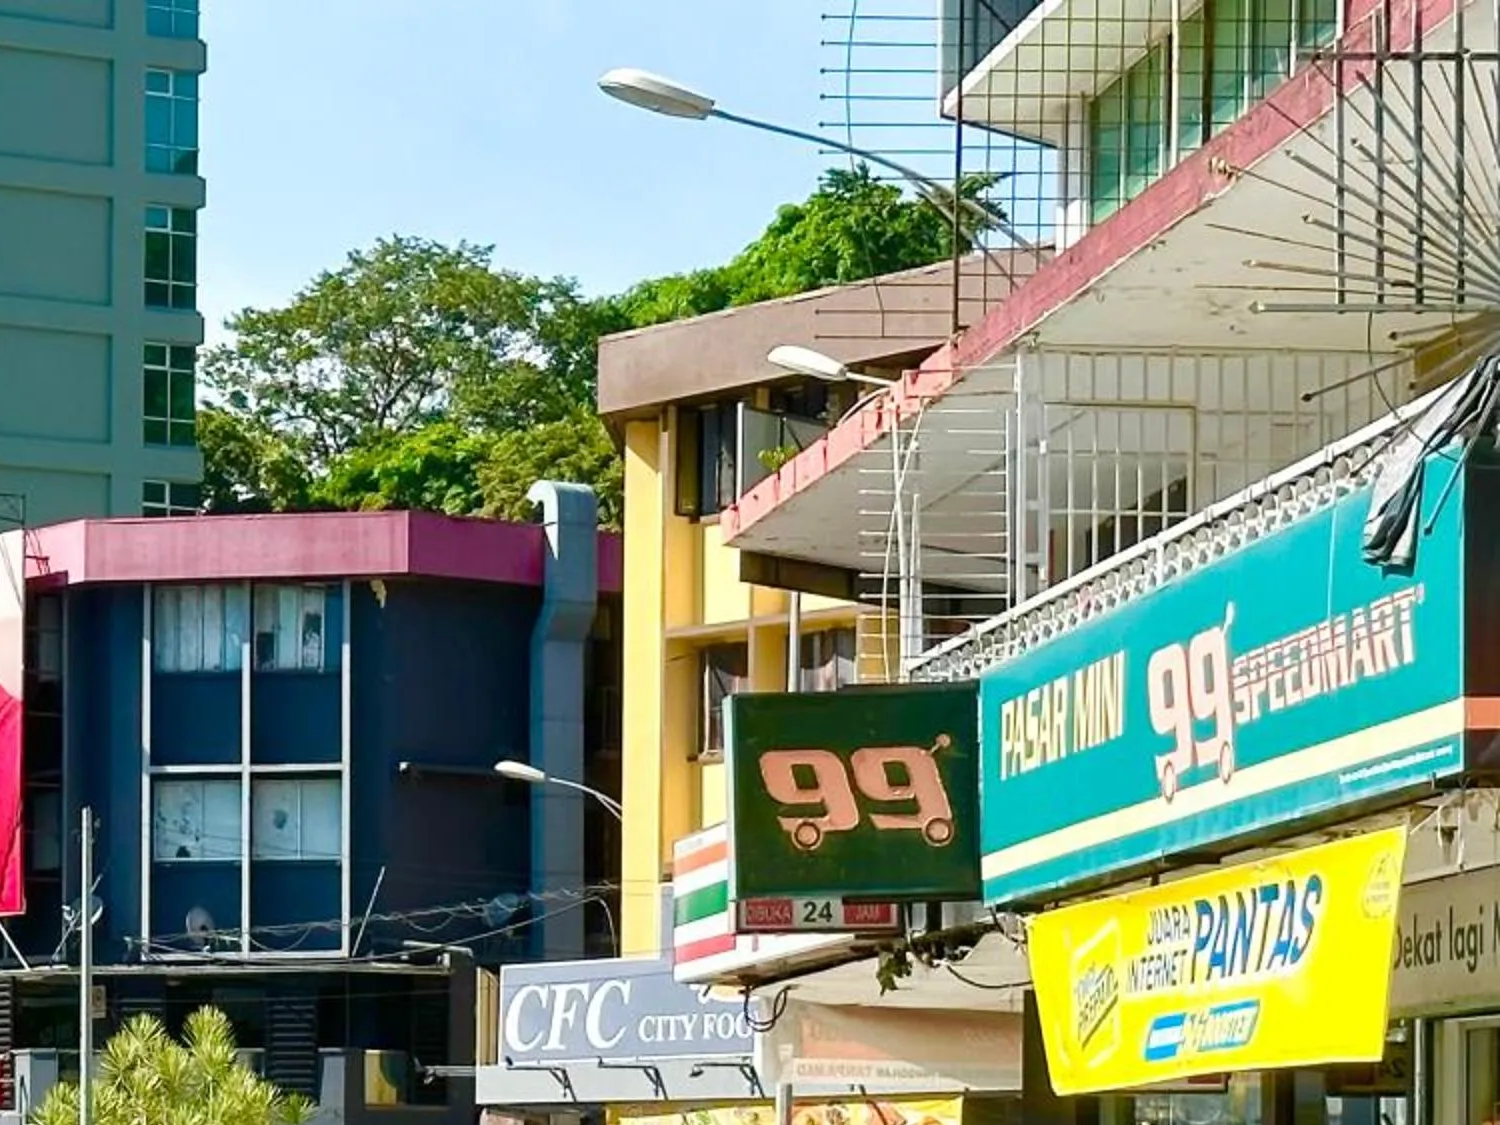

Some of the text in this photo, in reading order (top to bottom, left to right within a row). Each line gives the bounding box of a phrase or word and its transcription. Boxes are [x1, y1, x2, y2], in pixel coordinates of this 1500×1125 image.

[1001, 650, 1126, 780] PASAR MINI
[1148, 594, 1418, 802] 99 SPEEDMART
[760, 745, 955, 847] 99
[803, 901, 833, 923] 24
[1148, 904, 1191, 946] JUARA
[1190, 874, 1323, 984] PANTAS
[1449, 904, 1484, 974] lagi
[1128, 949, 1188, 993] INTERNET
[505, 979, 758, 1052] CFC CITY FOO
